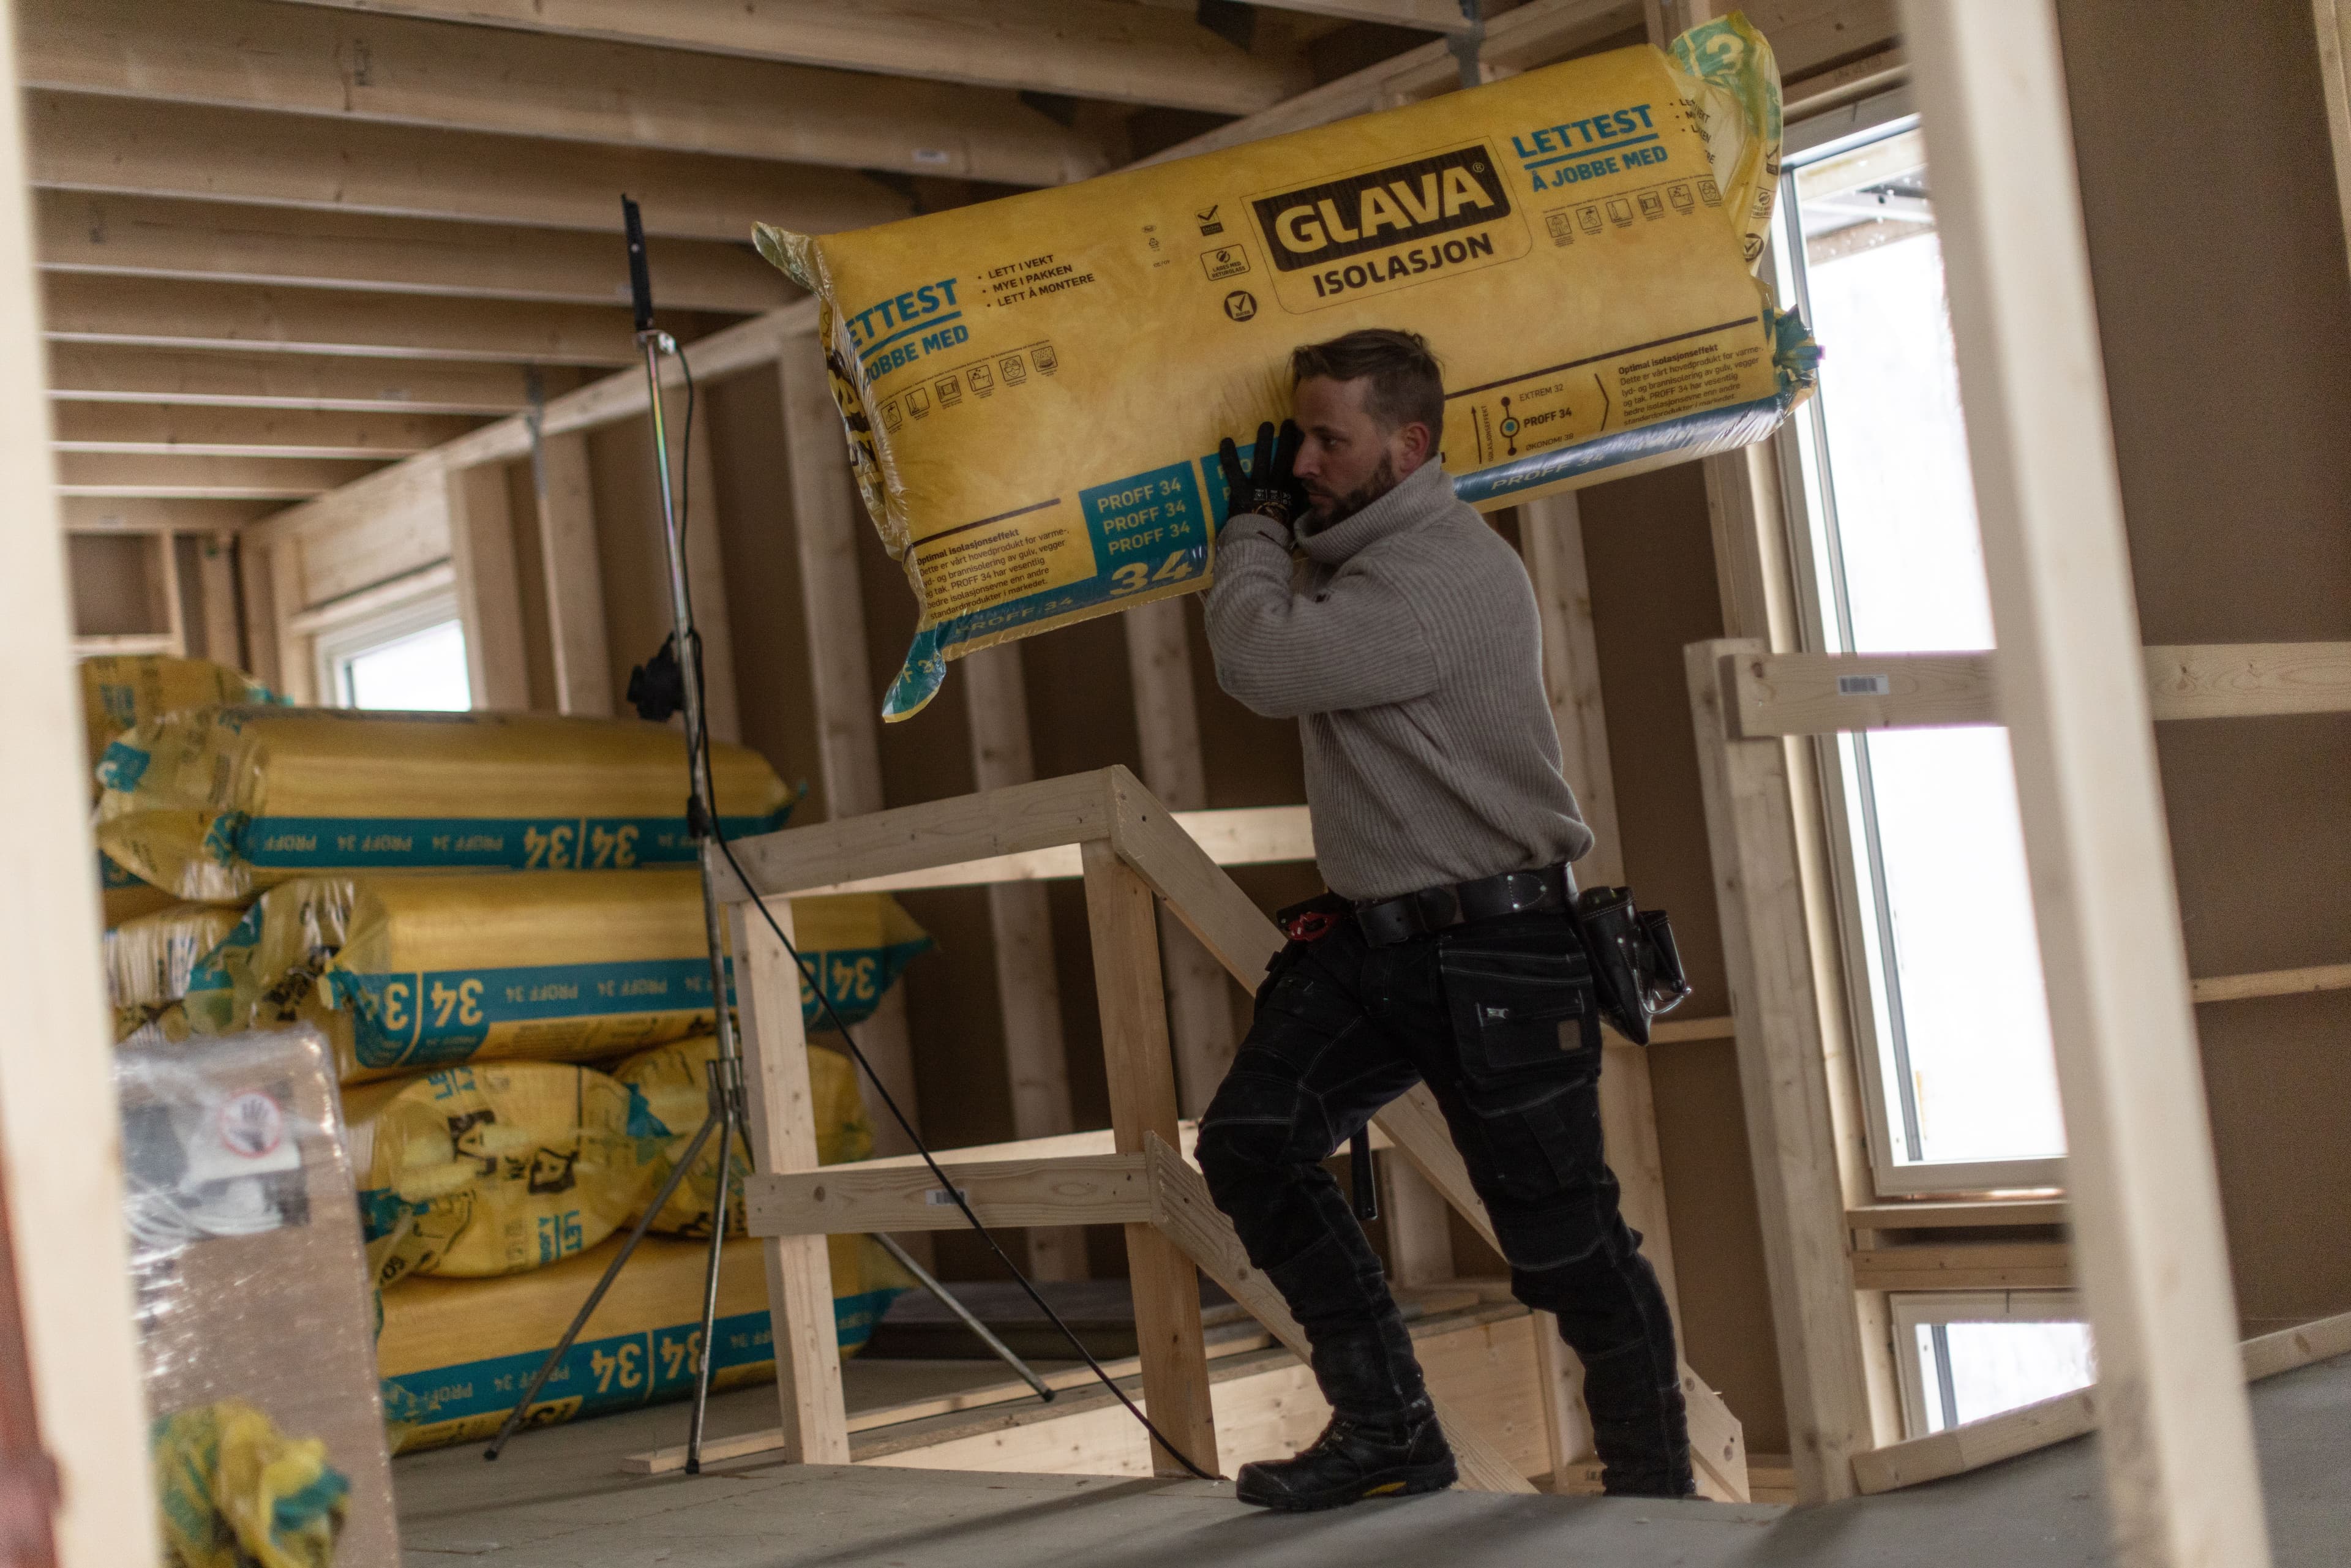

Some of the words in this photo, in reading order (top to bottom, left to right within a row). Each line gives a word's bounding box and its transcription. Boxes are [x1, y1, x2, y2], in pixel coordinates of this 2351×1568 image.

[1512, 103, 1654, 159] LETTEST
[1532, 170, 1548, 192] Å
[1551, 154, 1621, 187] JOBBE
[1624, 145, 1668, 171] MED
[1275, 165, 1494, 254] GLAVA
[988, 264, 1016, 279] LETT
[1024, 255, 1054, 269] VEKT
[993, 279, 1018, 293] MYE
[1026, 264, 1073, 284] PAKKEN
[1312, 232, 1494, 298] ISOLASJON
[997, 291, 1026, 307] LETT
[1029, 287, 1037, 298] Å
[1038, 273, 1095, 295] MONTERE
[845, 278, 957, 348] ETTEST
[921, 325, 969, 355] MED
[1618, 361, 1650, 375] Optimal
[1652, 343, 1719, 367] isolasjonseffekt
[1620, 376, 1641, 386] Dette
[1669, 354, 1721, 374] hovedprodukt
[1638, 384, 1647, 393] og
[1648, 370, 1703, 390] brannisolering
[1734, 357, 1760, 370] vegger
[1519, 386, 1553, 402] EXTREM
[1554, 383, 1564, 392] 32
[1623, 400, 1632, 408] og
[1649, 386, 1676, 400] PROFF
[1678, 383, 1689, 393] 34
[1690, 380, 1702, 390] har
[1704, 372, 1738, 387] vesentlig
[1624, 407, 1644, 417] bedre
[1719, 382, 1741, 394] andre
[1523, 410, 1556, 427] PROFF
[1559, 407, 1572, 419] 34
[1526, 437, 1562, 451] ØKONOMI
[1491, 460, 1572, 490] PROFF
[1097, 484, 1153, 513] PROFF
[1159, 476, 1182, 496] 34
[1103, 506, 1159, 535] PROFF
[1165, 499, 1187, 518] 34
[917, 550, 948, 567] Optimal
[949, 528, 1020, 556] isolasjonseffekt
[1108, 527, 1163, 556] PROFF
[1169, 520, 1190, 538] 34
[920, 566, 939, 577] Dette
[950, 557, 967, 567] vårt
[969, 541, 1024, 563] hovedprodukt
[923, 577, 936, 588] yd-
[937, 574, 947, 583] og
[949, 557, 1005, 579] brannisolering
[1038, 539, 1065, 553] vegger
[1109, 549, 1193, 596] 34
[926, 590, 934, 599] og
[951, 574, 979, 590] PROFF
[981, 572, 992, 581] 34
[993, 568, 1007, 579] har
[1009, 557, 1045, 574] vesentlig
[928, 597, 949, 609] bedre
[950, 579, 1009, 602] isolasjonsevne
[1010, 575, 1025, 584] enn
[1027, 566, 1049, 579] andre
[930, 591, 1002, 620] standardprodukter
[955, 606, 1036, 635] PROFF
[1044, 597, 1074, 612] 34
[525, 825, 574, 869] 34
[591, 825, 639, 868] 34
[833, 956, 876, 1001] 34
[430, 978, 484, 1027] 34
[590, 1343, 642, 1394] 34
